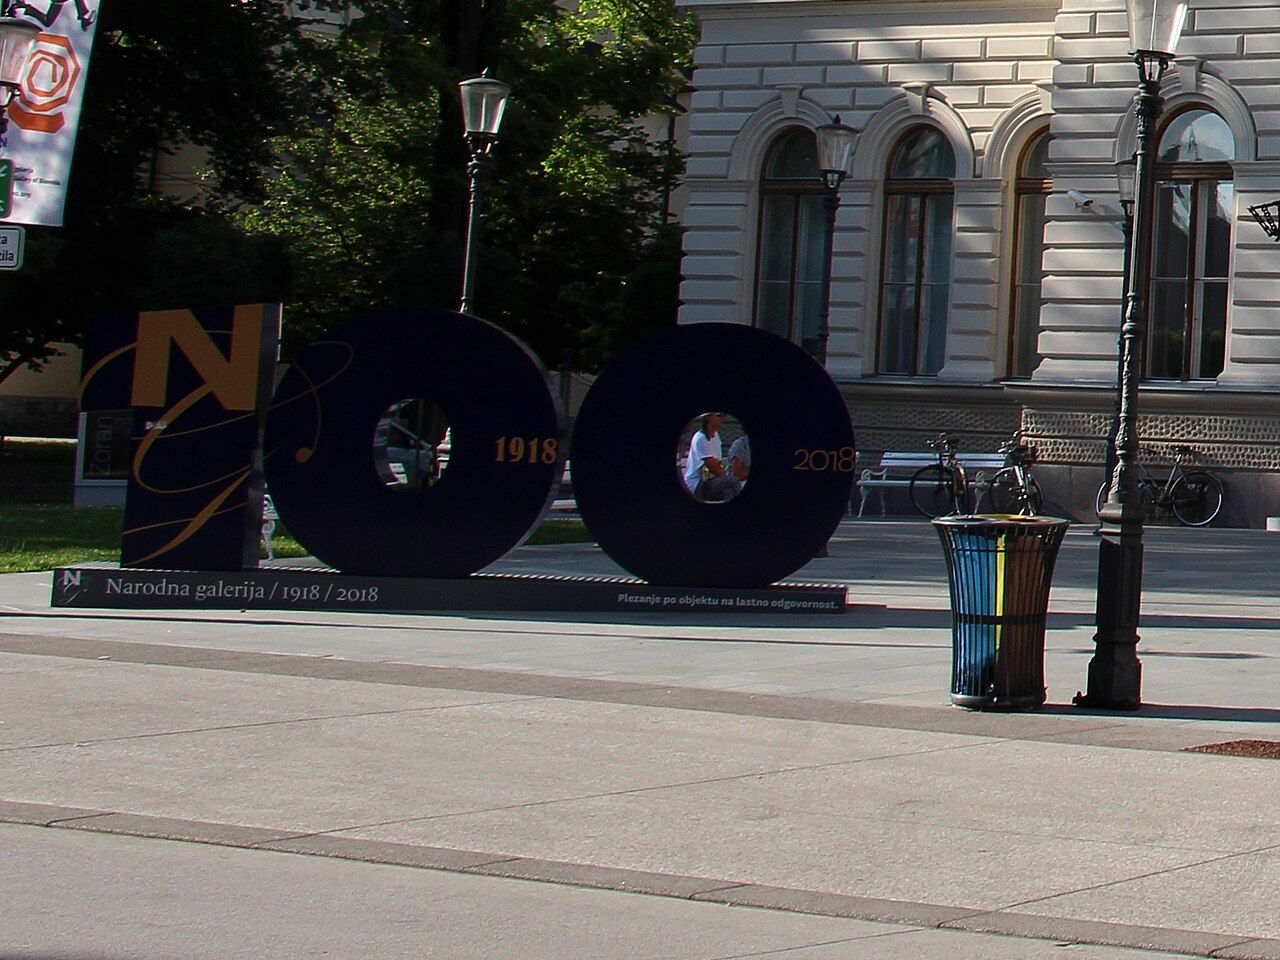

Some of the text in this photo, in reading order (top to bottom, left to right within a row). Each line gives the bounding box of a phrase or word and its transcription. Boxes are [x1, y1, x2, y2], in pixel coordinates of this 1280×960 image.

[131, 303, 265, 411] N
[495, 436, 558, 464] 1918
[793, 446, 856, 472] 2018
[106, 578, 190, 597] Narodna
[195, 579, 265, 604] galerija
[283, 583, 320, 602] 1918
[337, 586, 379, 603] 2018
[618, 593, 839, 610] Plezanje po objektu na lastno odgovornost.
